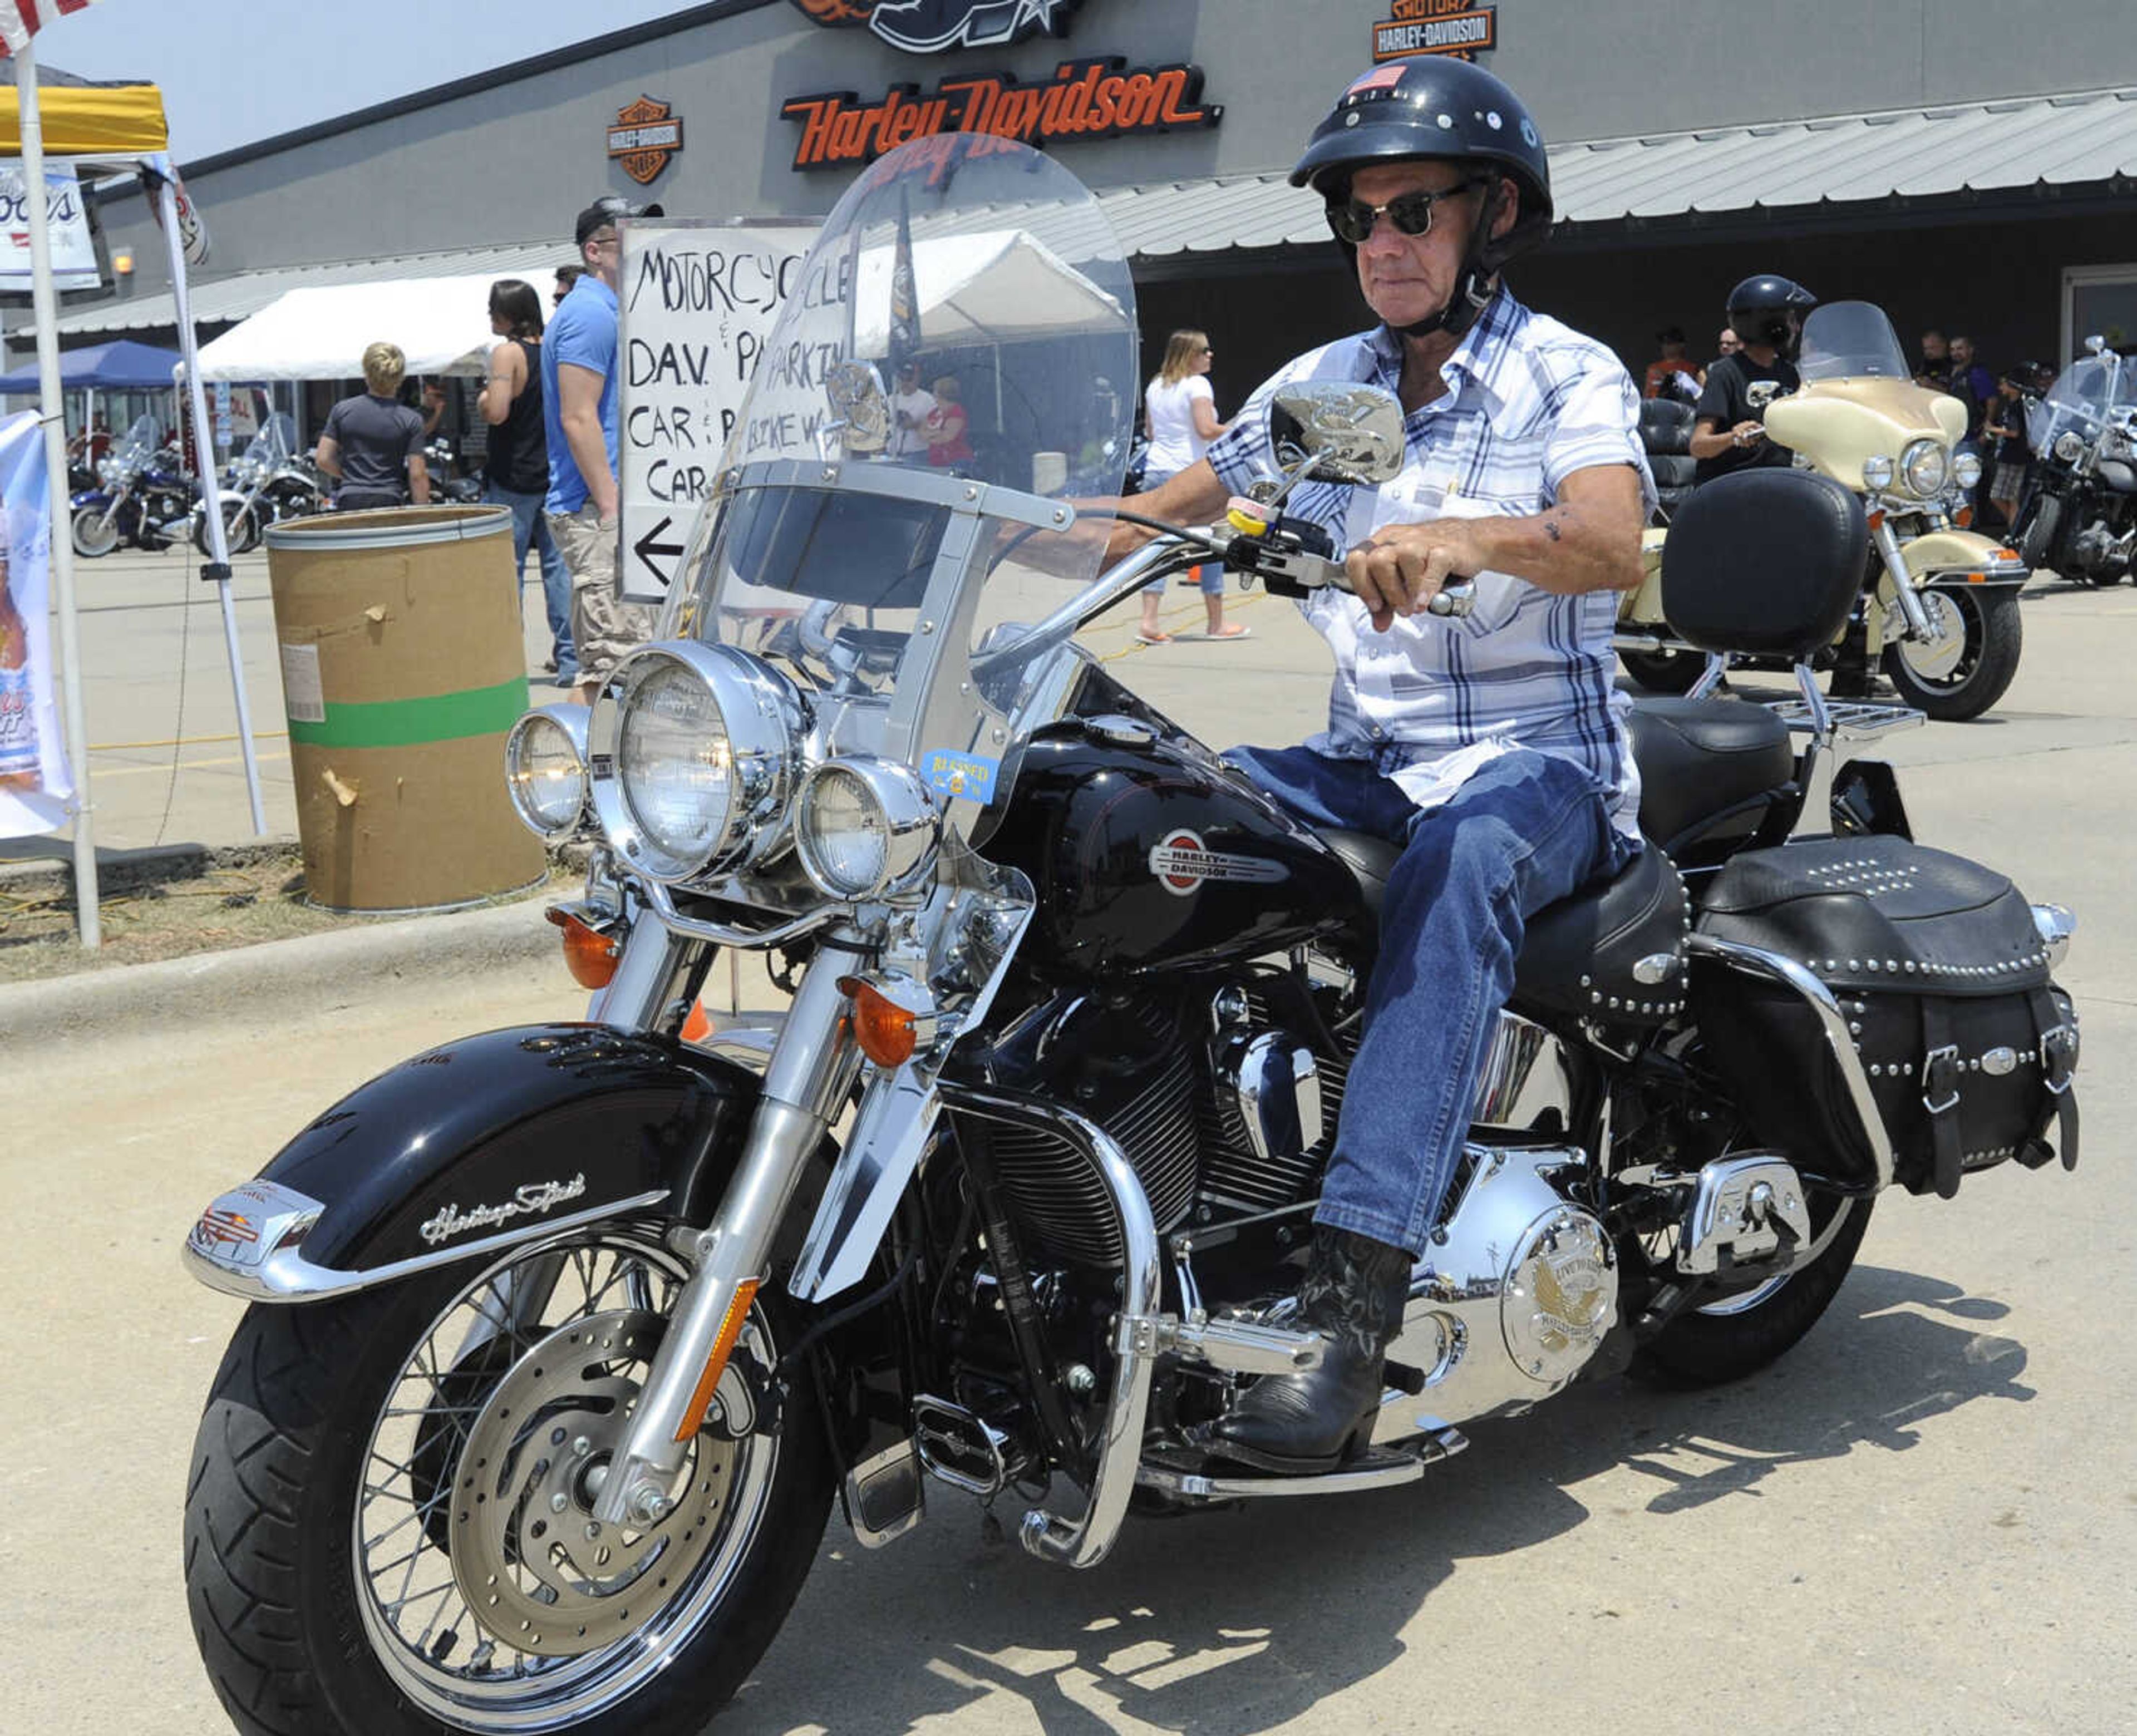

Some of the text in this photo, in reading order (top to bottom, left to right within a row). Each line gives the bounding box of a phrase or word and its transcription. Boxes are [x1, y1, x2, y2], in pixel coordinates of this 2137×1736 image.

[1377, 17, 1486, 52] HARLEY-DAVIDSON
[785, 65, 1204, 185] Harley-Davidson
[628, 406, 695, 450] CAR
[647, 459, 706, 503] CAR
[1171, 864, 1227, 877] DAVIDSON
